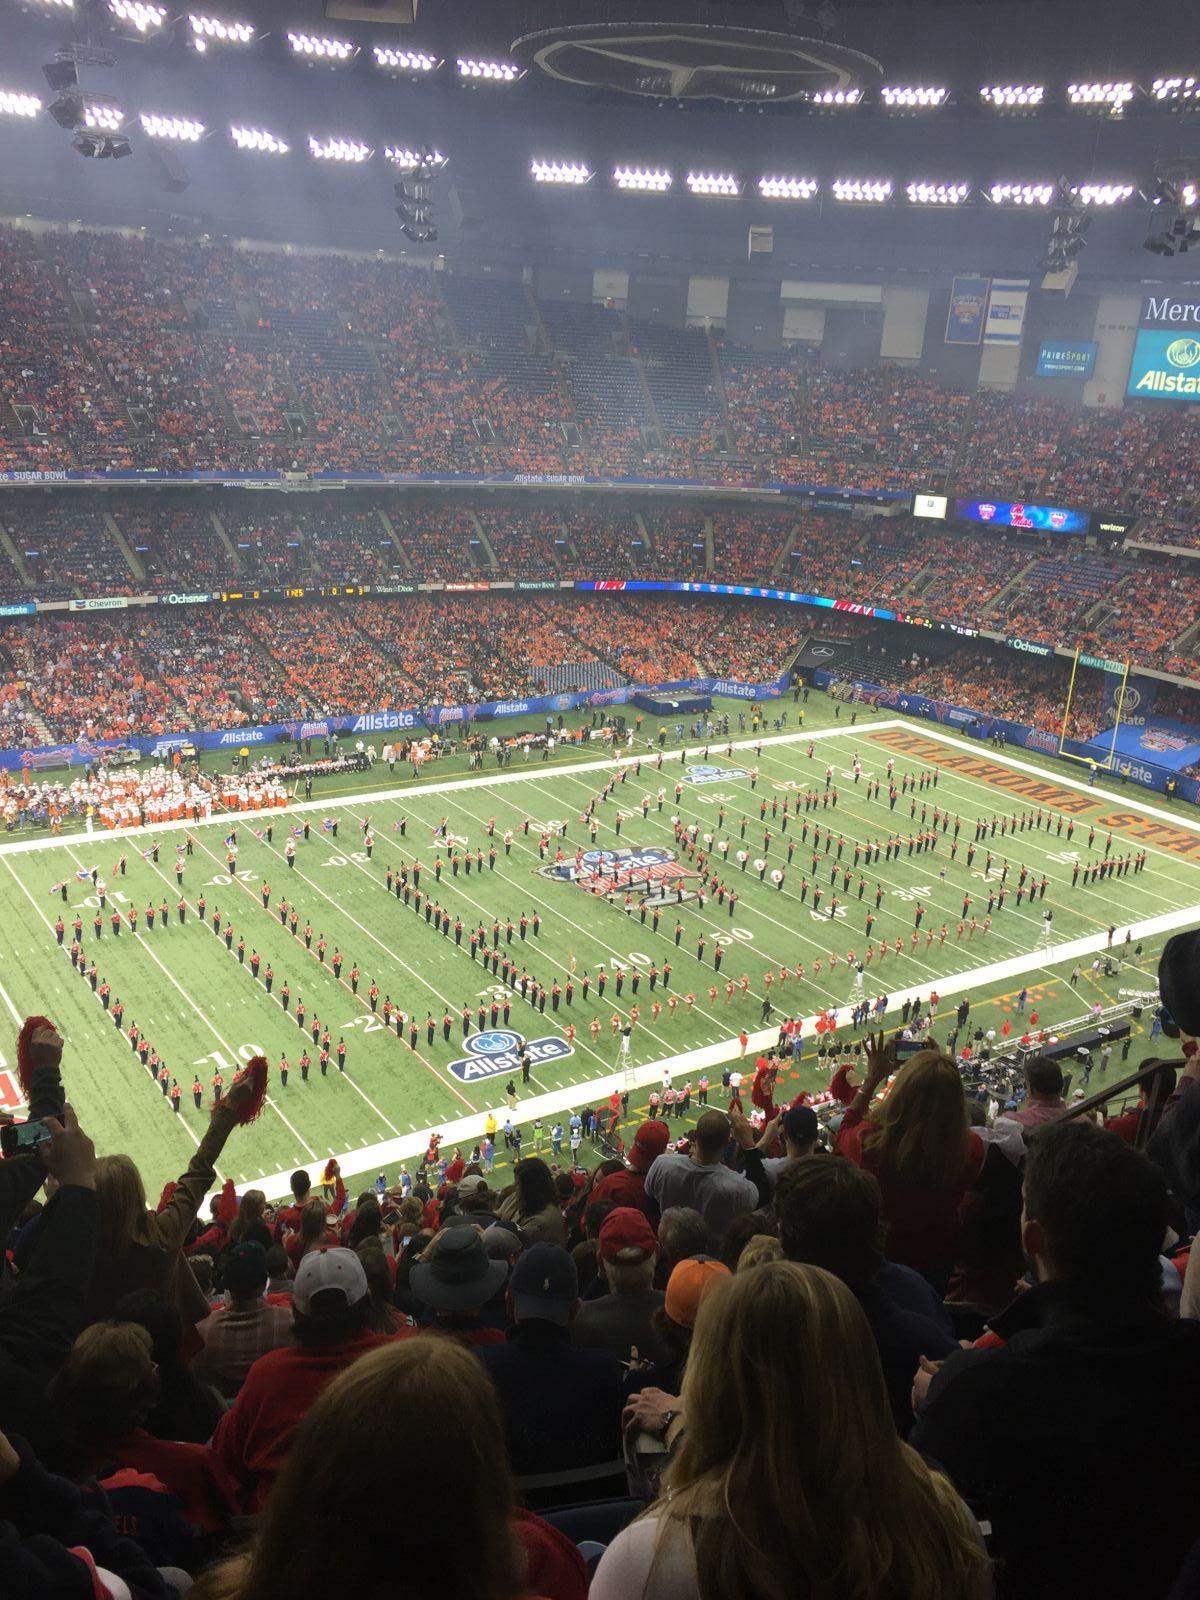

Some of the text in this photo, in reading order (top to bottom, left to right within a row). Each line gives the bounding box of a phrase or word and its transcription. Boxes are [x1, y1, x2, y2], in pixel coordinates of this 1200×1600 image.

[14, 471, 42, 480] SUGAR
[45, 470, 69, 480] BOWL
[1011, 515, 1034, 528] Miss
[1100, 523, 1125, 533] verizon
[88, 600, 122, 608] Chevron
[169, 593, 209, 605] Ochsner
[1013, 638, 1050, 657] Ochsner
[711, 681, 756, 697] Allstate
[494, 703, 528, 715] Allstate
[352, 712, 415, 732] Allstate
[220, 731, 264, 745] Allstate
[867, 731, 1105, 815] OKLAHOMA
[709, 927, 754, 946] 50
[463, 1042, 563, 1080] Allstate
